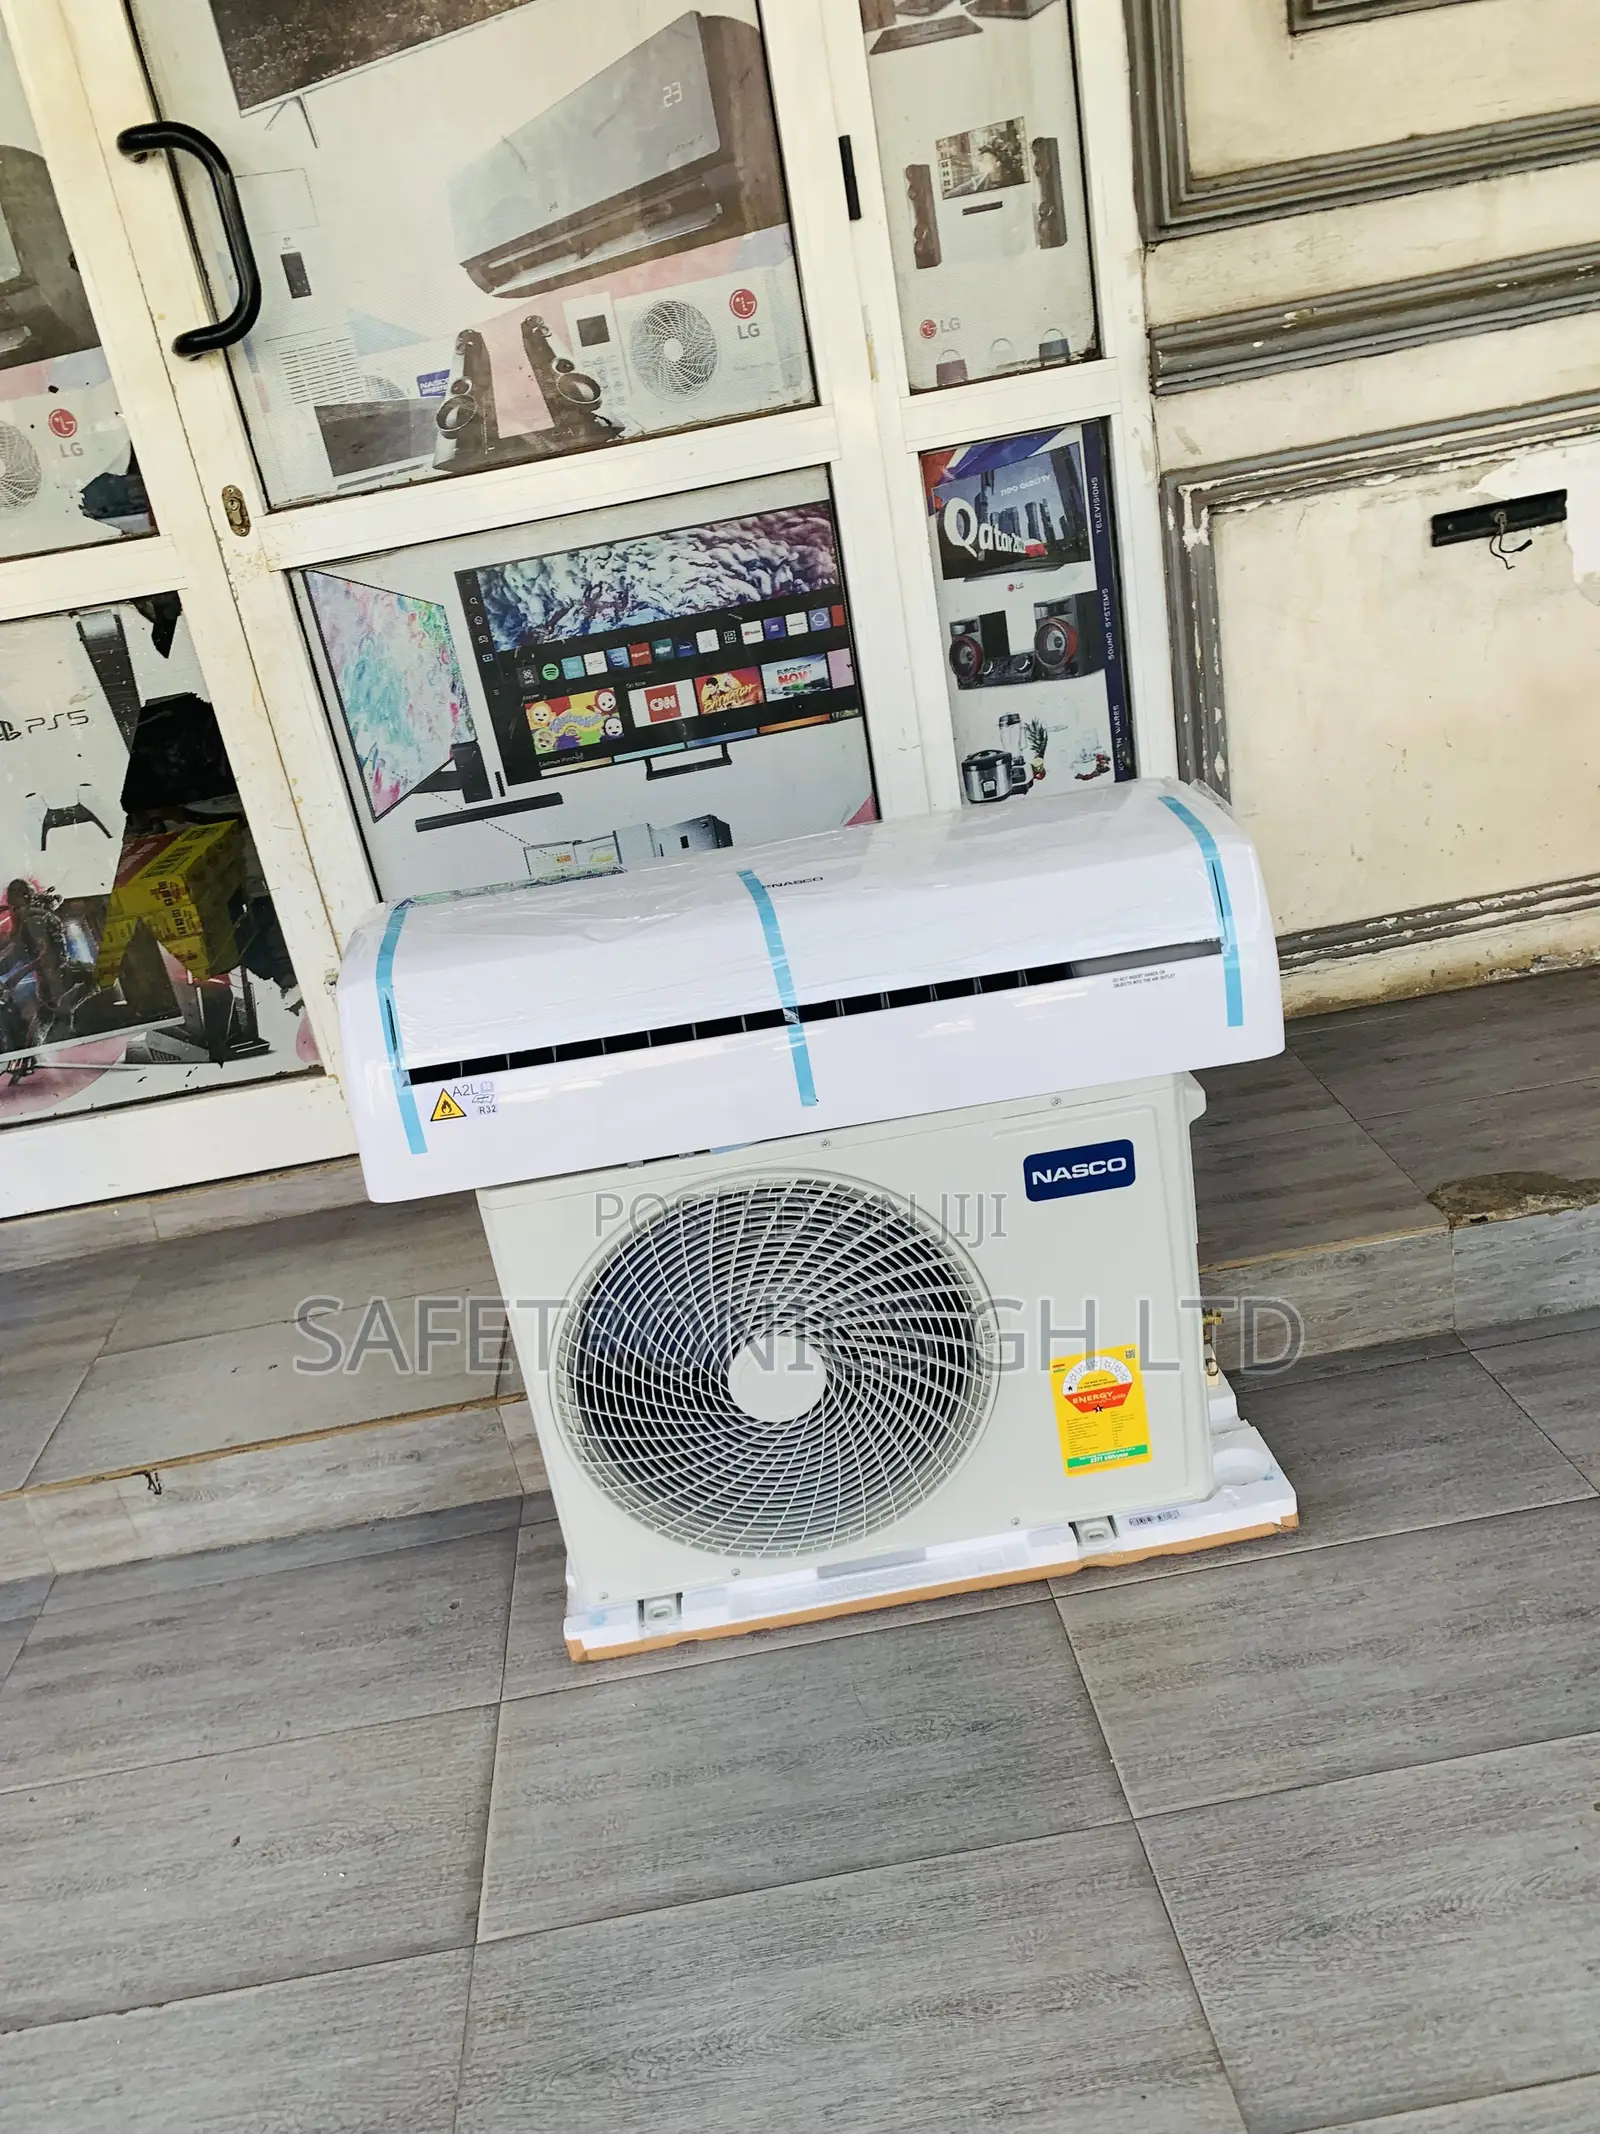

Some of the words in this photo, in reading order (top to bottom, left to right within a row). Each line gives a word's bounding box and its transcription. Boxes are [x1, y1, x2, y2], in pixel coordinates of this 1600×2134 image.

[662, 82, 683, 108] 23
[737, 322, 760, 340] LG
[940, 317, 961, 333] LG
[59, 442, 84, 458] LG
[1091, 476, 1103, 535] TELEVISIONS
[1101, 587, 1112, 628] SYSTEMS
[1107, 632, 1115, 661] SOUND
[650, 694, 676, 712] CNN
[25, 709, 89, 734] PS5
[772, 876, 824, 888] NASCO
[453, 1083, 479, 1097] A2L
[479, 1105, 496, 1114] R32
[1032, 1157, 1127, 1185] NASCO
[1072, 1391, 1113, 1404] ENERGY
